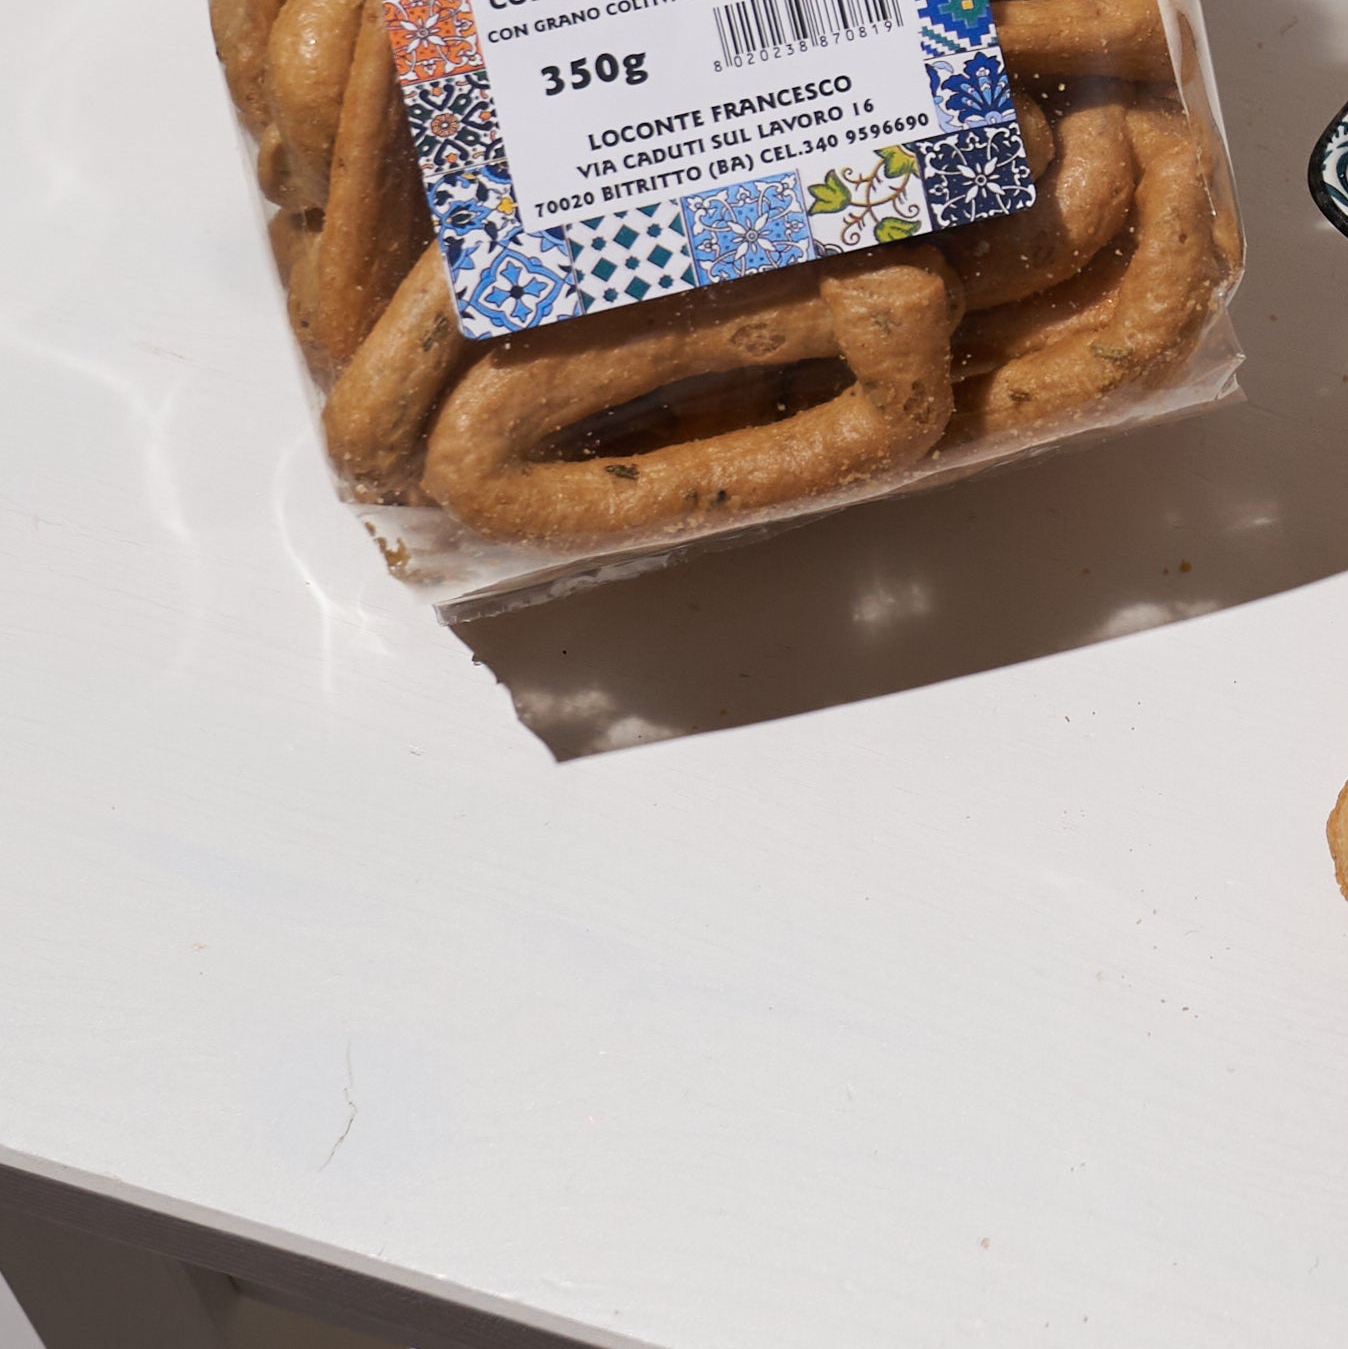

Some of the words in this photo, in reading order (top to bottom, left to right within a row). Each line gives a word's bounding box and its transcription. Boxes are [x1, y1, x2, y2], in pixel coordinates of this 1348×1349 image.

[487, 23, 529, 44] CON
[533, 7, 601, 33] GRANO
[540, 52, 649, 97] 350g
[576, 159, 618, 179] VIA
[622, 138, 705, 170] CADUTI
[710, 128, 752, 150] SUL
[757, 105, 844, 139] LAVORO
[852, 98, 874, 117] 16
[587, 109, 705, 151] LOCONTE
[710, 75, 852, 123] FRANCESCO
[534, 191, 595, 218] 70020
[601, 166, 702, 202] BITRITTO
[708, 154, 754, 180] (BA)
[845, 112, 929, 145] 9596690
